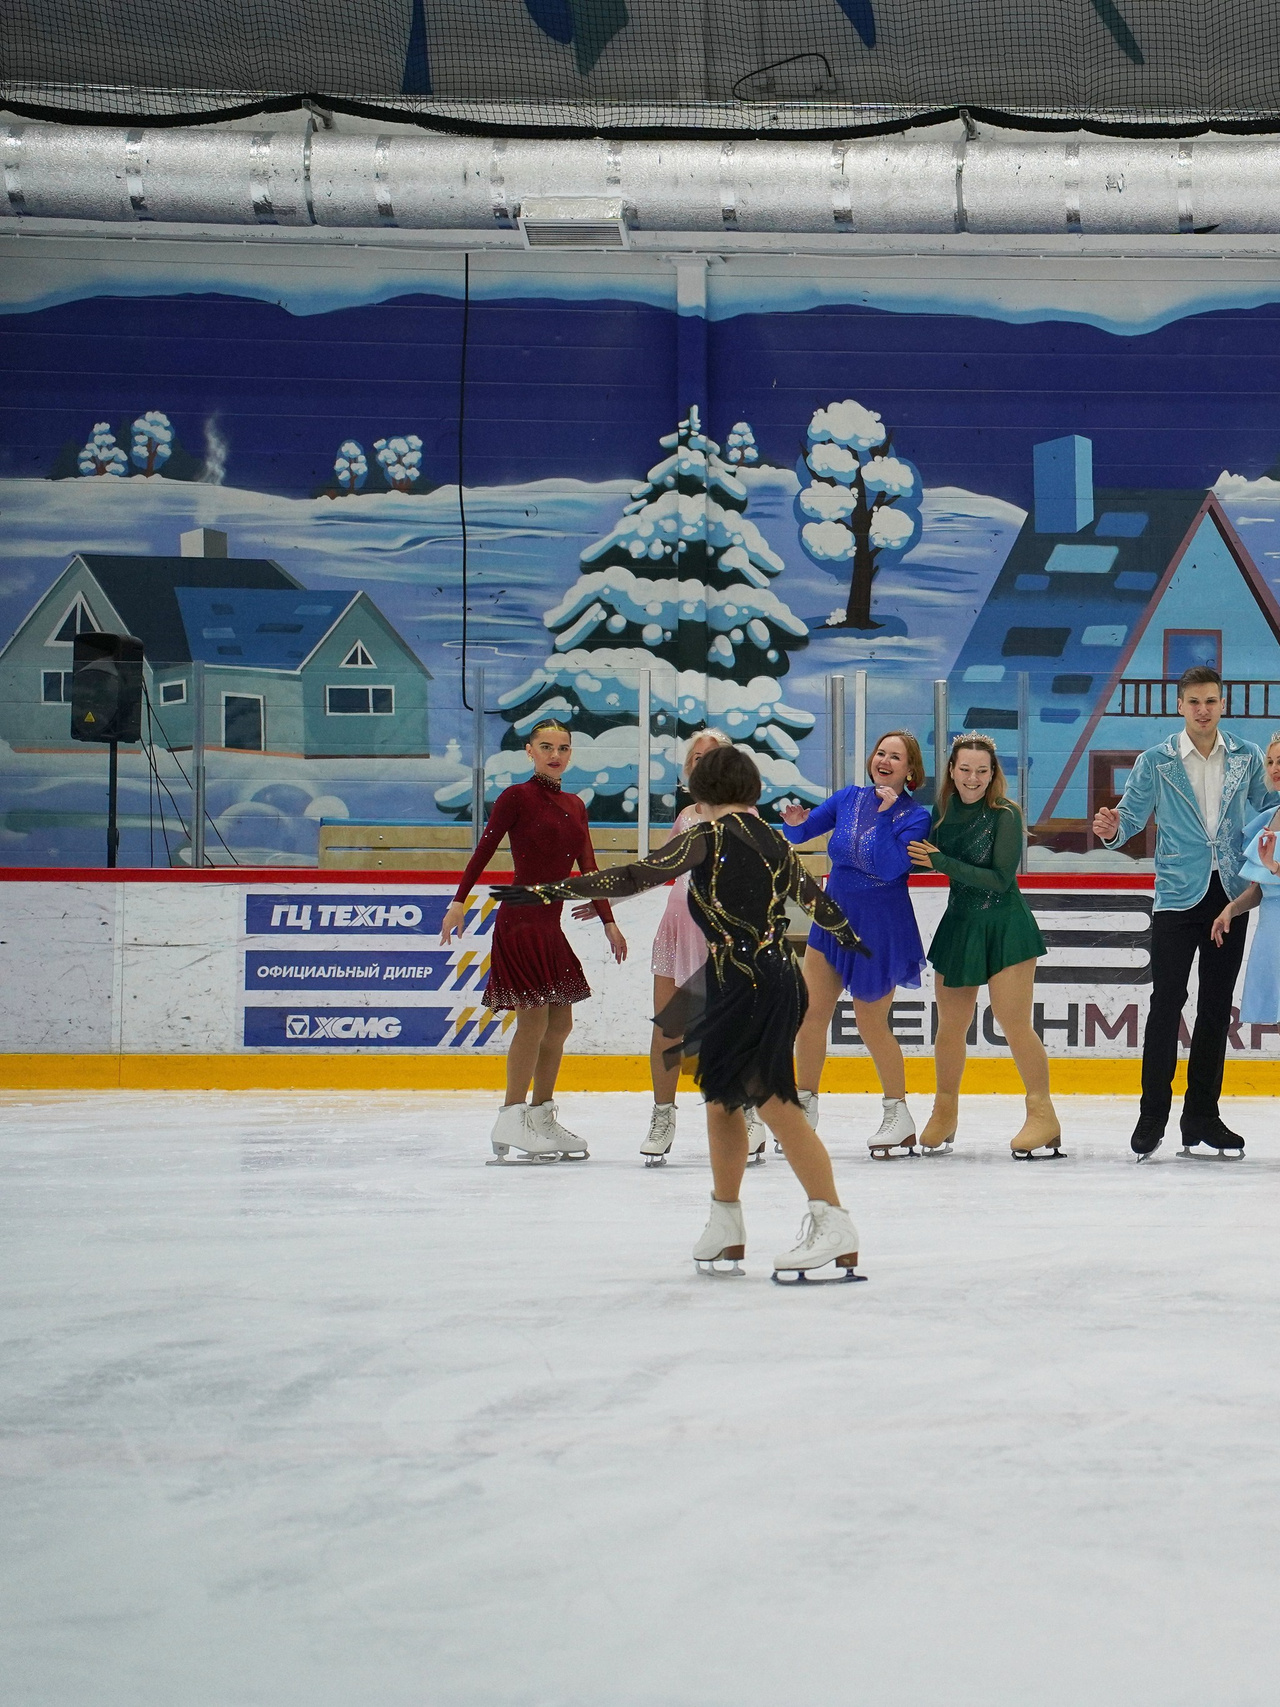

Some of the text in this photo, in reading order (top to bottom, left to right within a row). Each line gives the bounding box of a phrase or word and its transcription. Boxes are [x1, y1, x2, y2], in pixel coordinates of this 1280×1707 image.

[270, 904, 423, 931] ГЦ ТЕХНО
[256, 963, 433, 981] ОФИЦИАЛЬНЫЙ ДИЛЕР
[308, 1016, 402, 1039] XCMG
